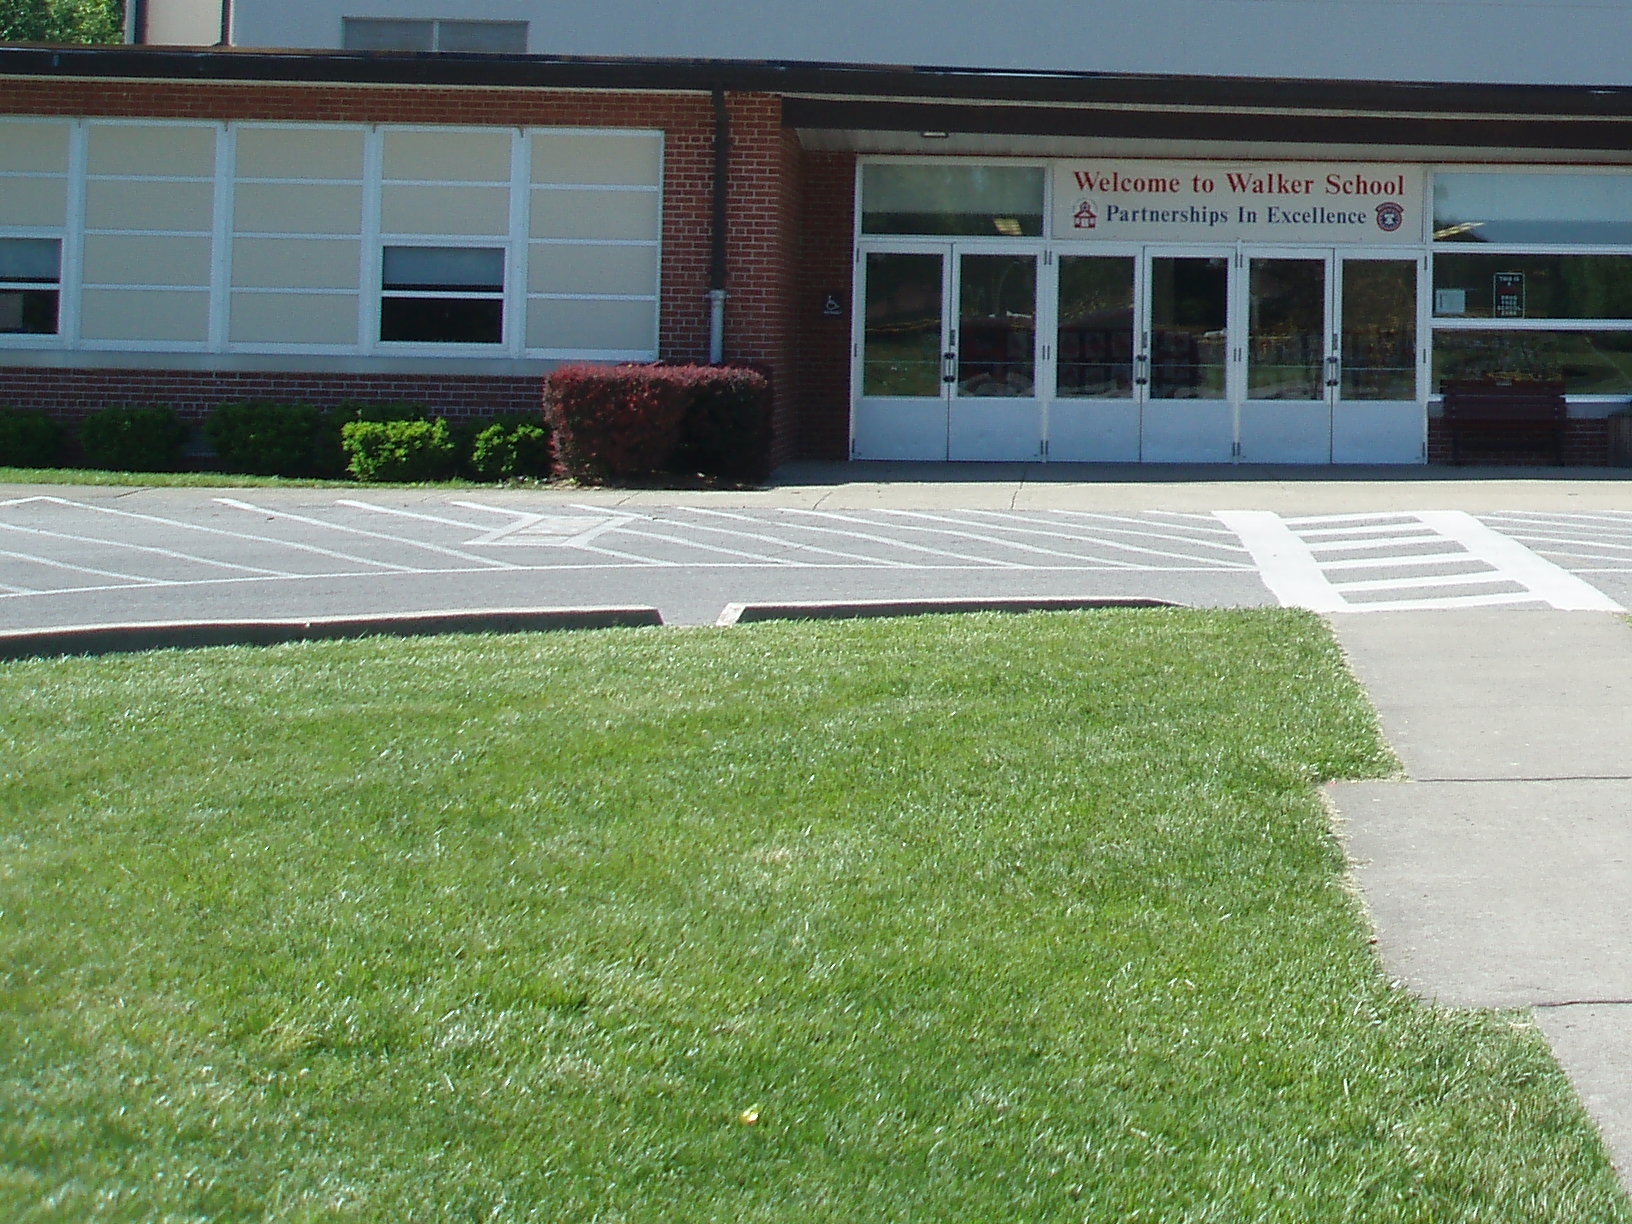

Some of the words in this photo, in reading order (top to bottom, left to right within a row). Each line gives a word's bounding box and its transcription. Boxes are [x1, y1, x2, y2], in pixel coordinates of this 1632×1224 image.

[1073, 170, 1180, 193] Welcome
[1192, 175, 1215, 193] to
[1226, 173, 1315, 194] Walker
[1325, 174, 1404, 196] School
[1106, 204, 1229, 226] Partnerships
[1238, 206, 1257, 223] In
[1267, 206, 1367, 224] Excellence
